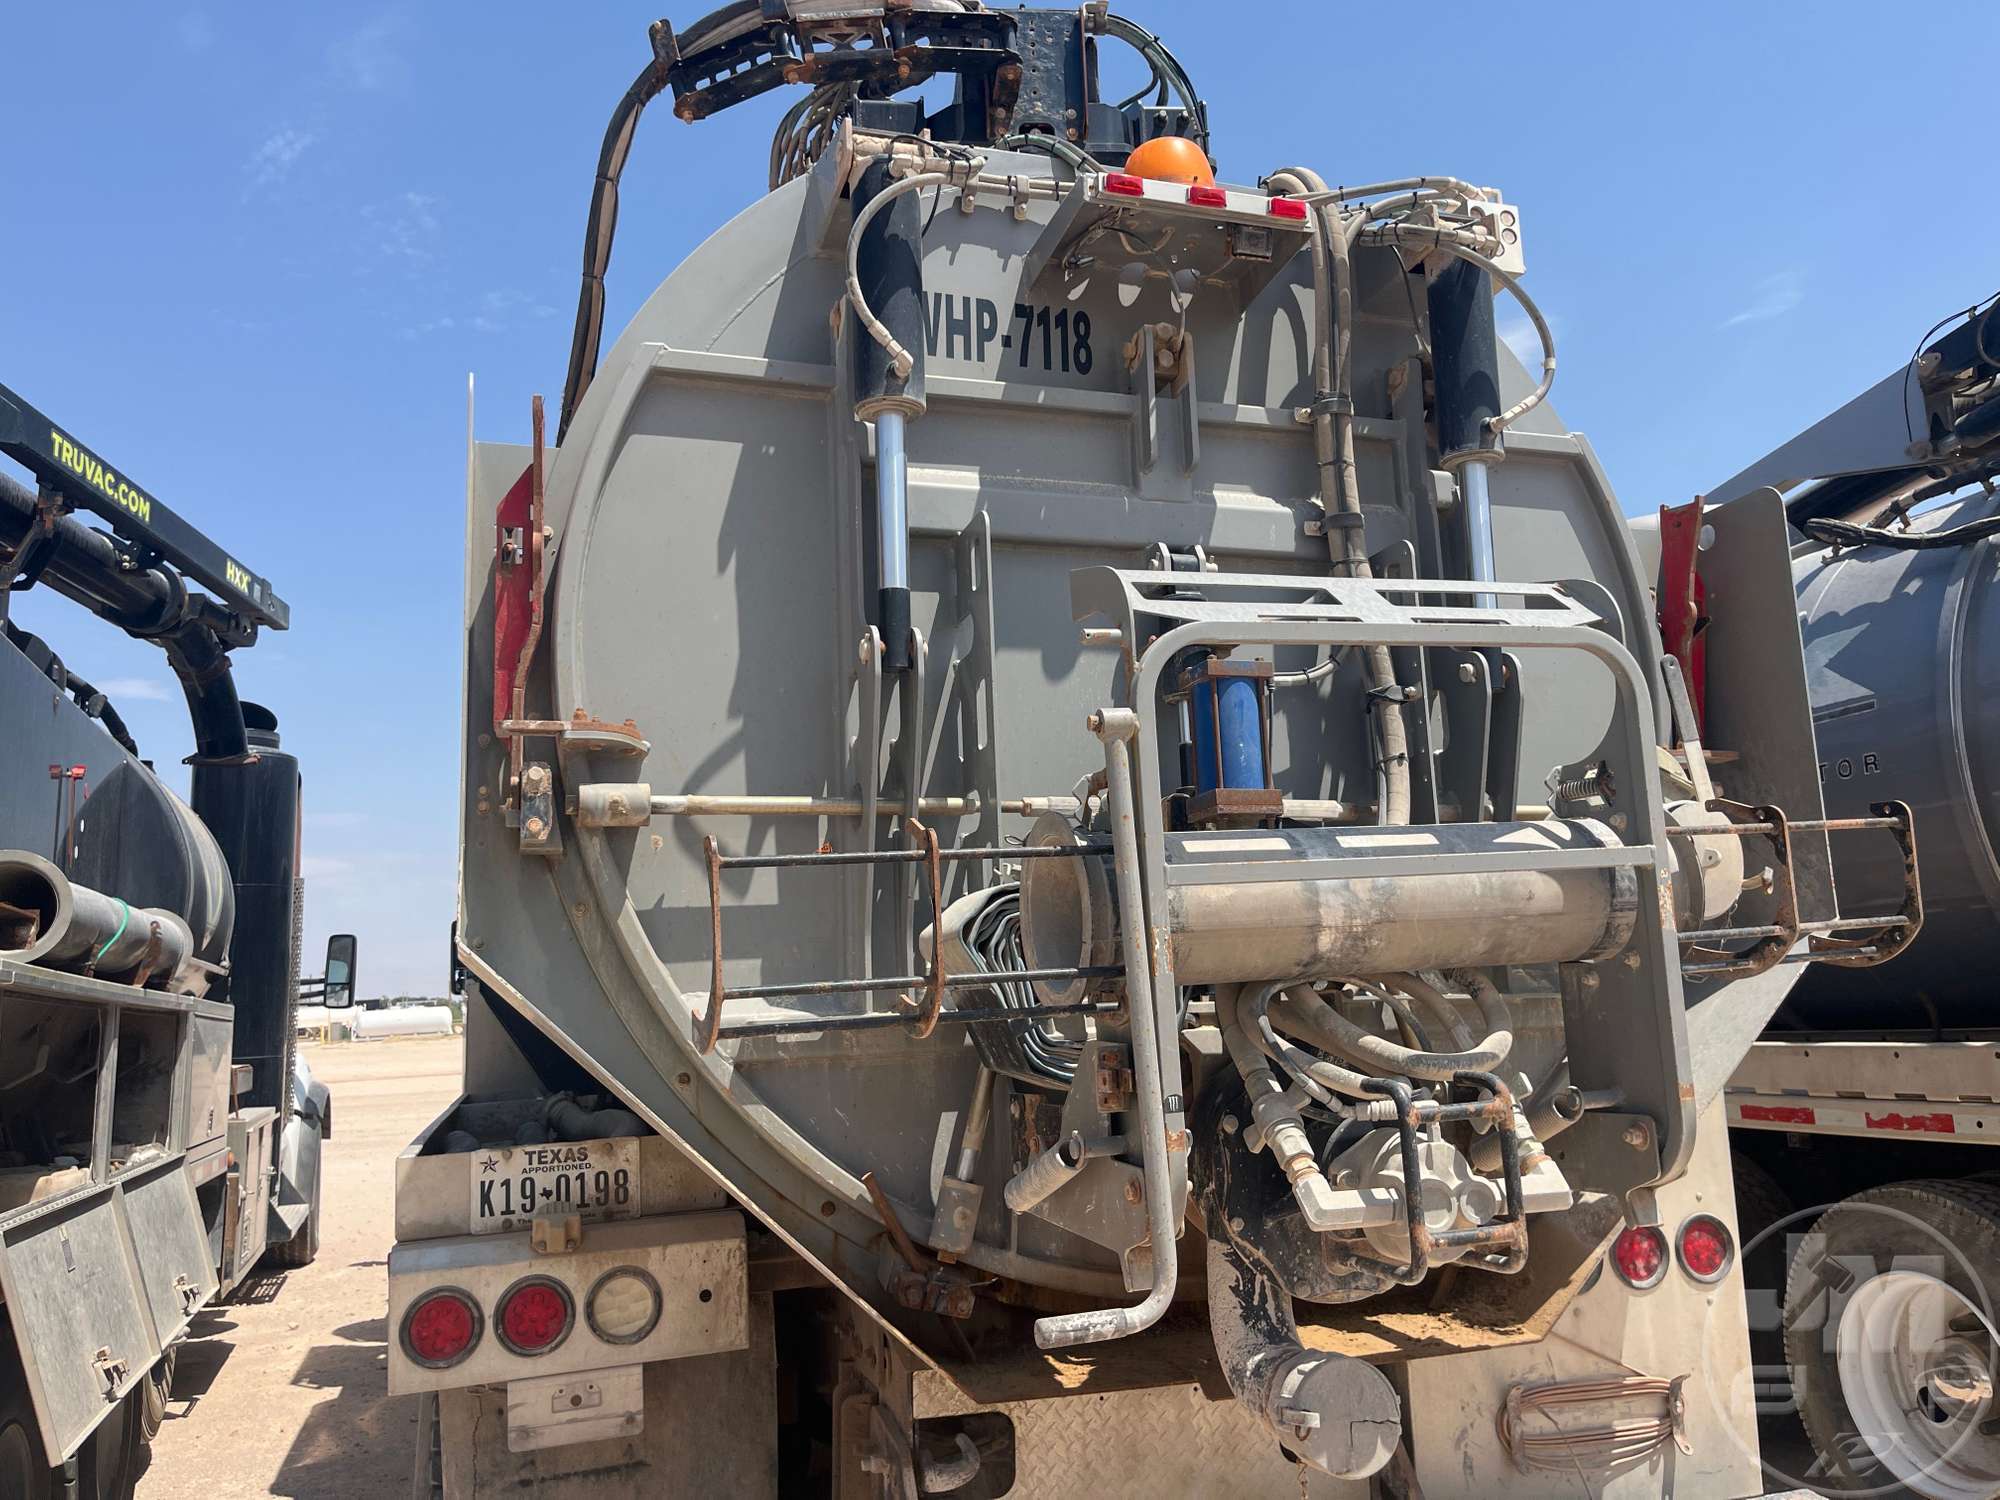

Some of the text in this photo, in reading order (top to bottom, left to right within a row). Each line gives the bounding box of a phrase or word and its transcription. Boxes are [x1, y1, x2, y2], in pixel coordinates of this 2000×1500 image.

[51, 431, 151, 522] TRUVAC.COM
[225, 560, 250, 592] HXX
[521, 1163, 593, 1175] APPORTIONED
[524, 1146, 589, 1166] TEXAS
